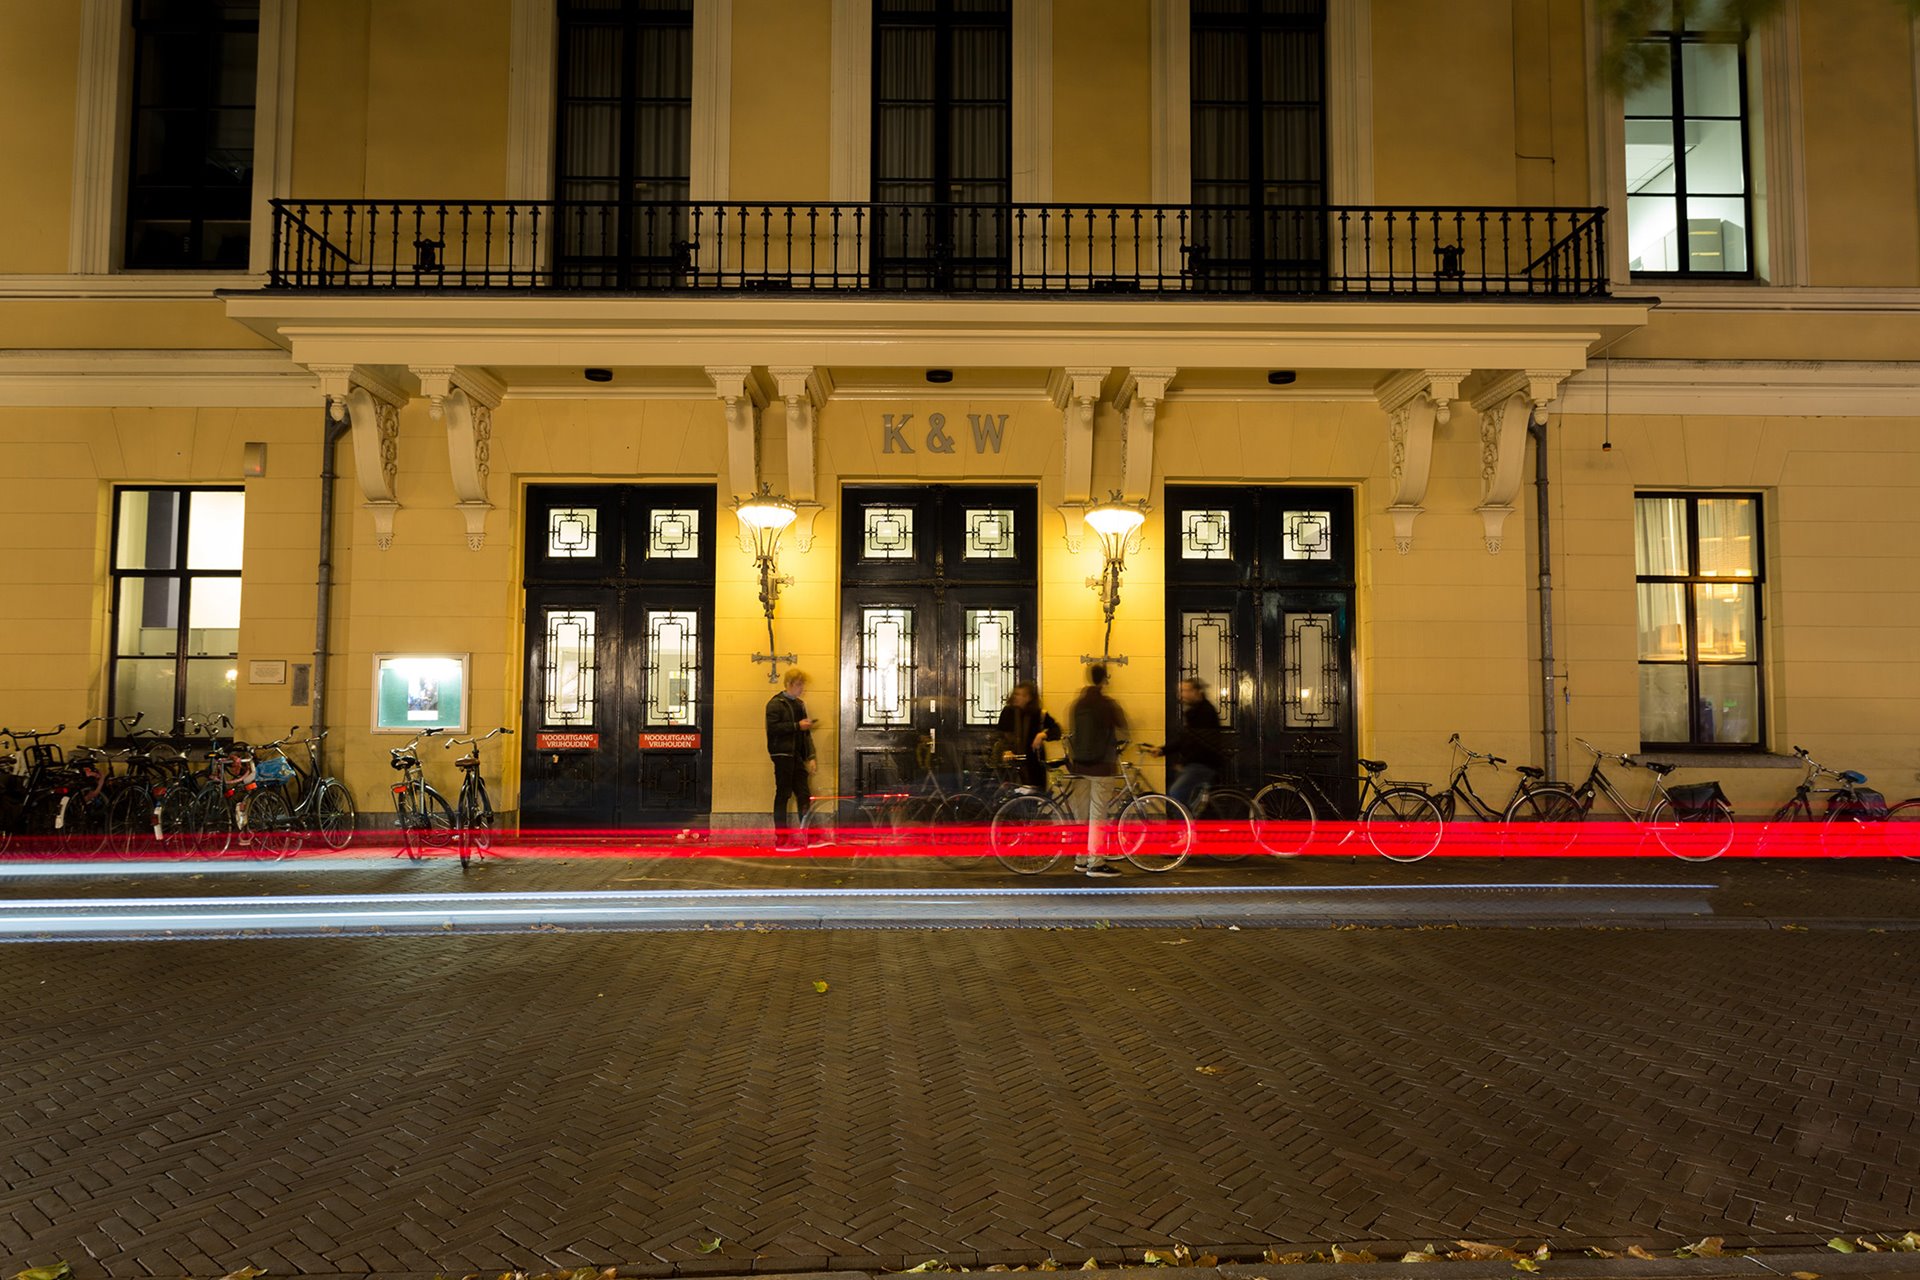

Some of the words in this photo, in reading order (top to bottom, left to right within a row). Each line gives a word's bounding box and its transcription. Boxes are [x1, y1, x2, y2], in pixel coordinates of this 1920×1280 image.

[882, 414, 916, 454] K
[926, 412, 956, 454] &
[966, 414, 1010, 454] W
